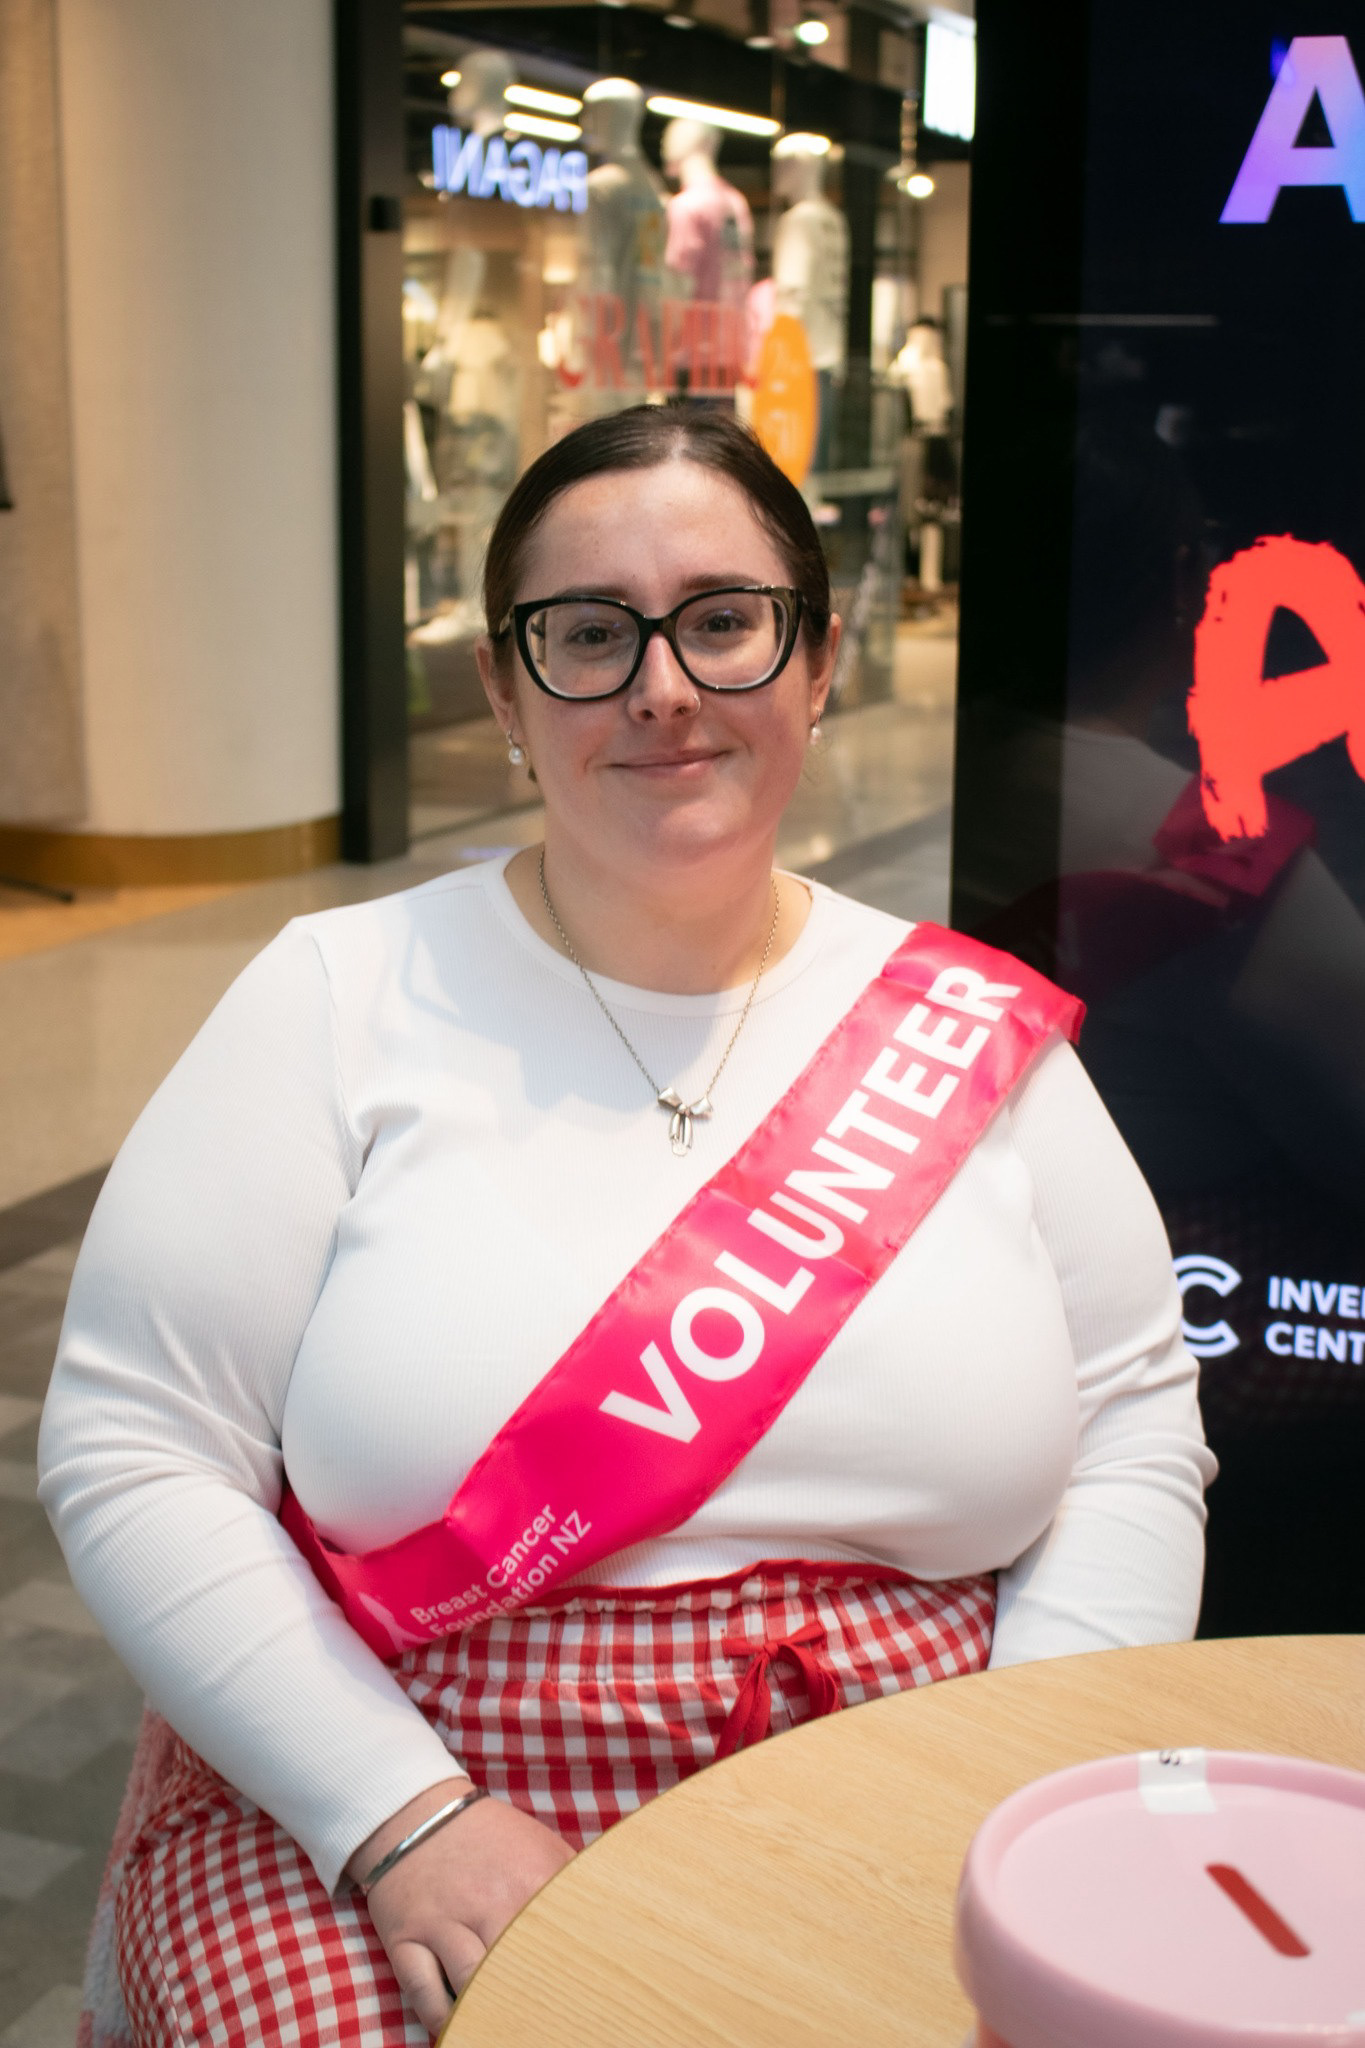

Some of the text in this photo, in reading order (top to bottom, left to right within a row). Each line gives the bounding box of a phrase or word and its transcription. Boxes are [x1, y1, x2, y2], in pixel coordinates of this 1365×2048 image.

[598, 966, 1022, 1444] VOLUNTEER
[1268, 1275, 1365, 1320] INVE
[410, 1504, 556, 1625] Breast Cancer
[550, 1509, 592, 1555] NZ
